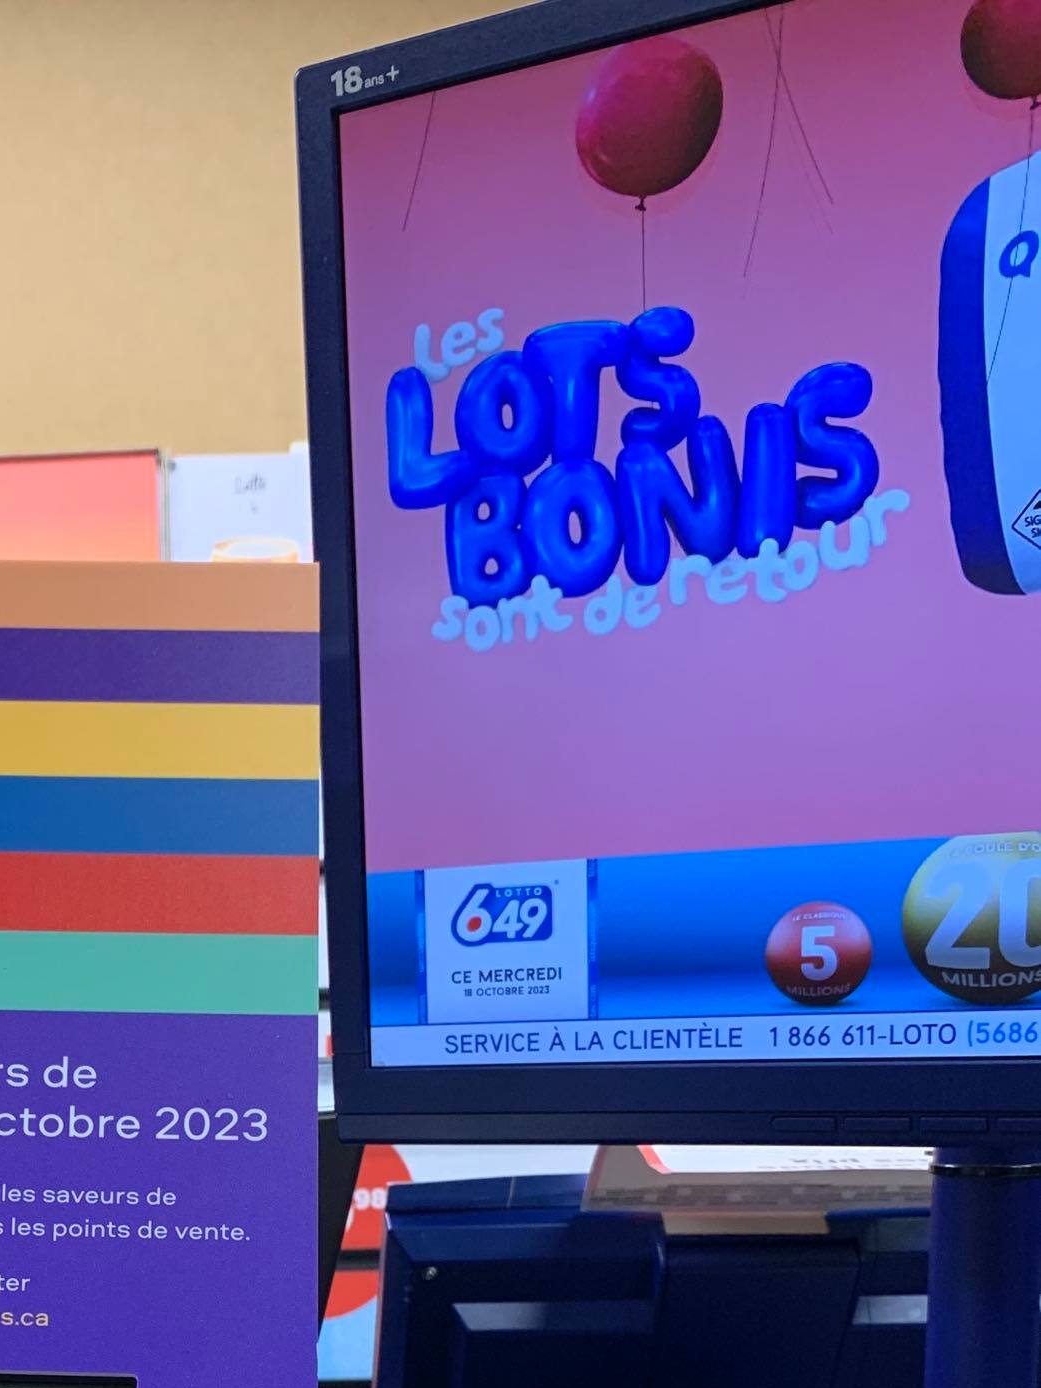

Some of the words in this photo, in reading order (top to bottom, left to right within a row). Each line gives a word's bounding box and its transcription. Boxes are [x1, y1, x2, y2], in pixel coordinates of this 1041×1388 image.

[413, 307, 505, 383] Les
[386, 307, 700, 510] LOTS
[446, 362, 880, 607] BONIS
[431, 576, 572, 652] sont
[584, 577, 660, 636] de
[668, 489, 910, 606] retour
[495, 887, 543, 898] LOTTO
[456, 888, 548, 942] 649
[801, 925, 838, 982] 5
[451, 970, 472, 984] CE
[479, 967, 562, 983] MERCREDI
[476, 986, 524, 997] OCTOBRE
[528, 985, 550, 995] 2023
[785, 983, 851, 998] MILLIONS
[444, 1029, 543, 1055] SERVICE
[549, 1022, 563, 1052] À
[573, 1029, 604, 1052] LA
[612, 1021, 743, 1051] CLIENTÈLE
[770, 1026, 779, 1047] 1
[788, 1025, 832, 1047] 866
[841, 1023, 957, 1046] 611-LOTO
[43, 1056, 98, 1089] de
[155, 1107, 269, 1142] 2023
[1, 1184, 36, 1203] les
[42, 1188, 139, 1205] saveurs
[146, 1188, 177, 1206] de
[11, 1217, 45, 1237] les
[53, 1219, 131, 1241] points
[137, 1220, 168, 1239] de
[175, 1222, 251, 1241] vente.
